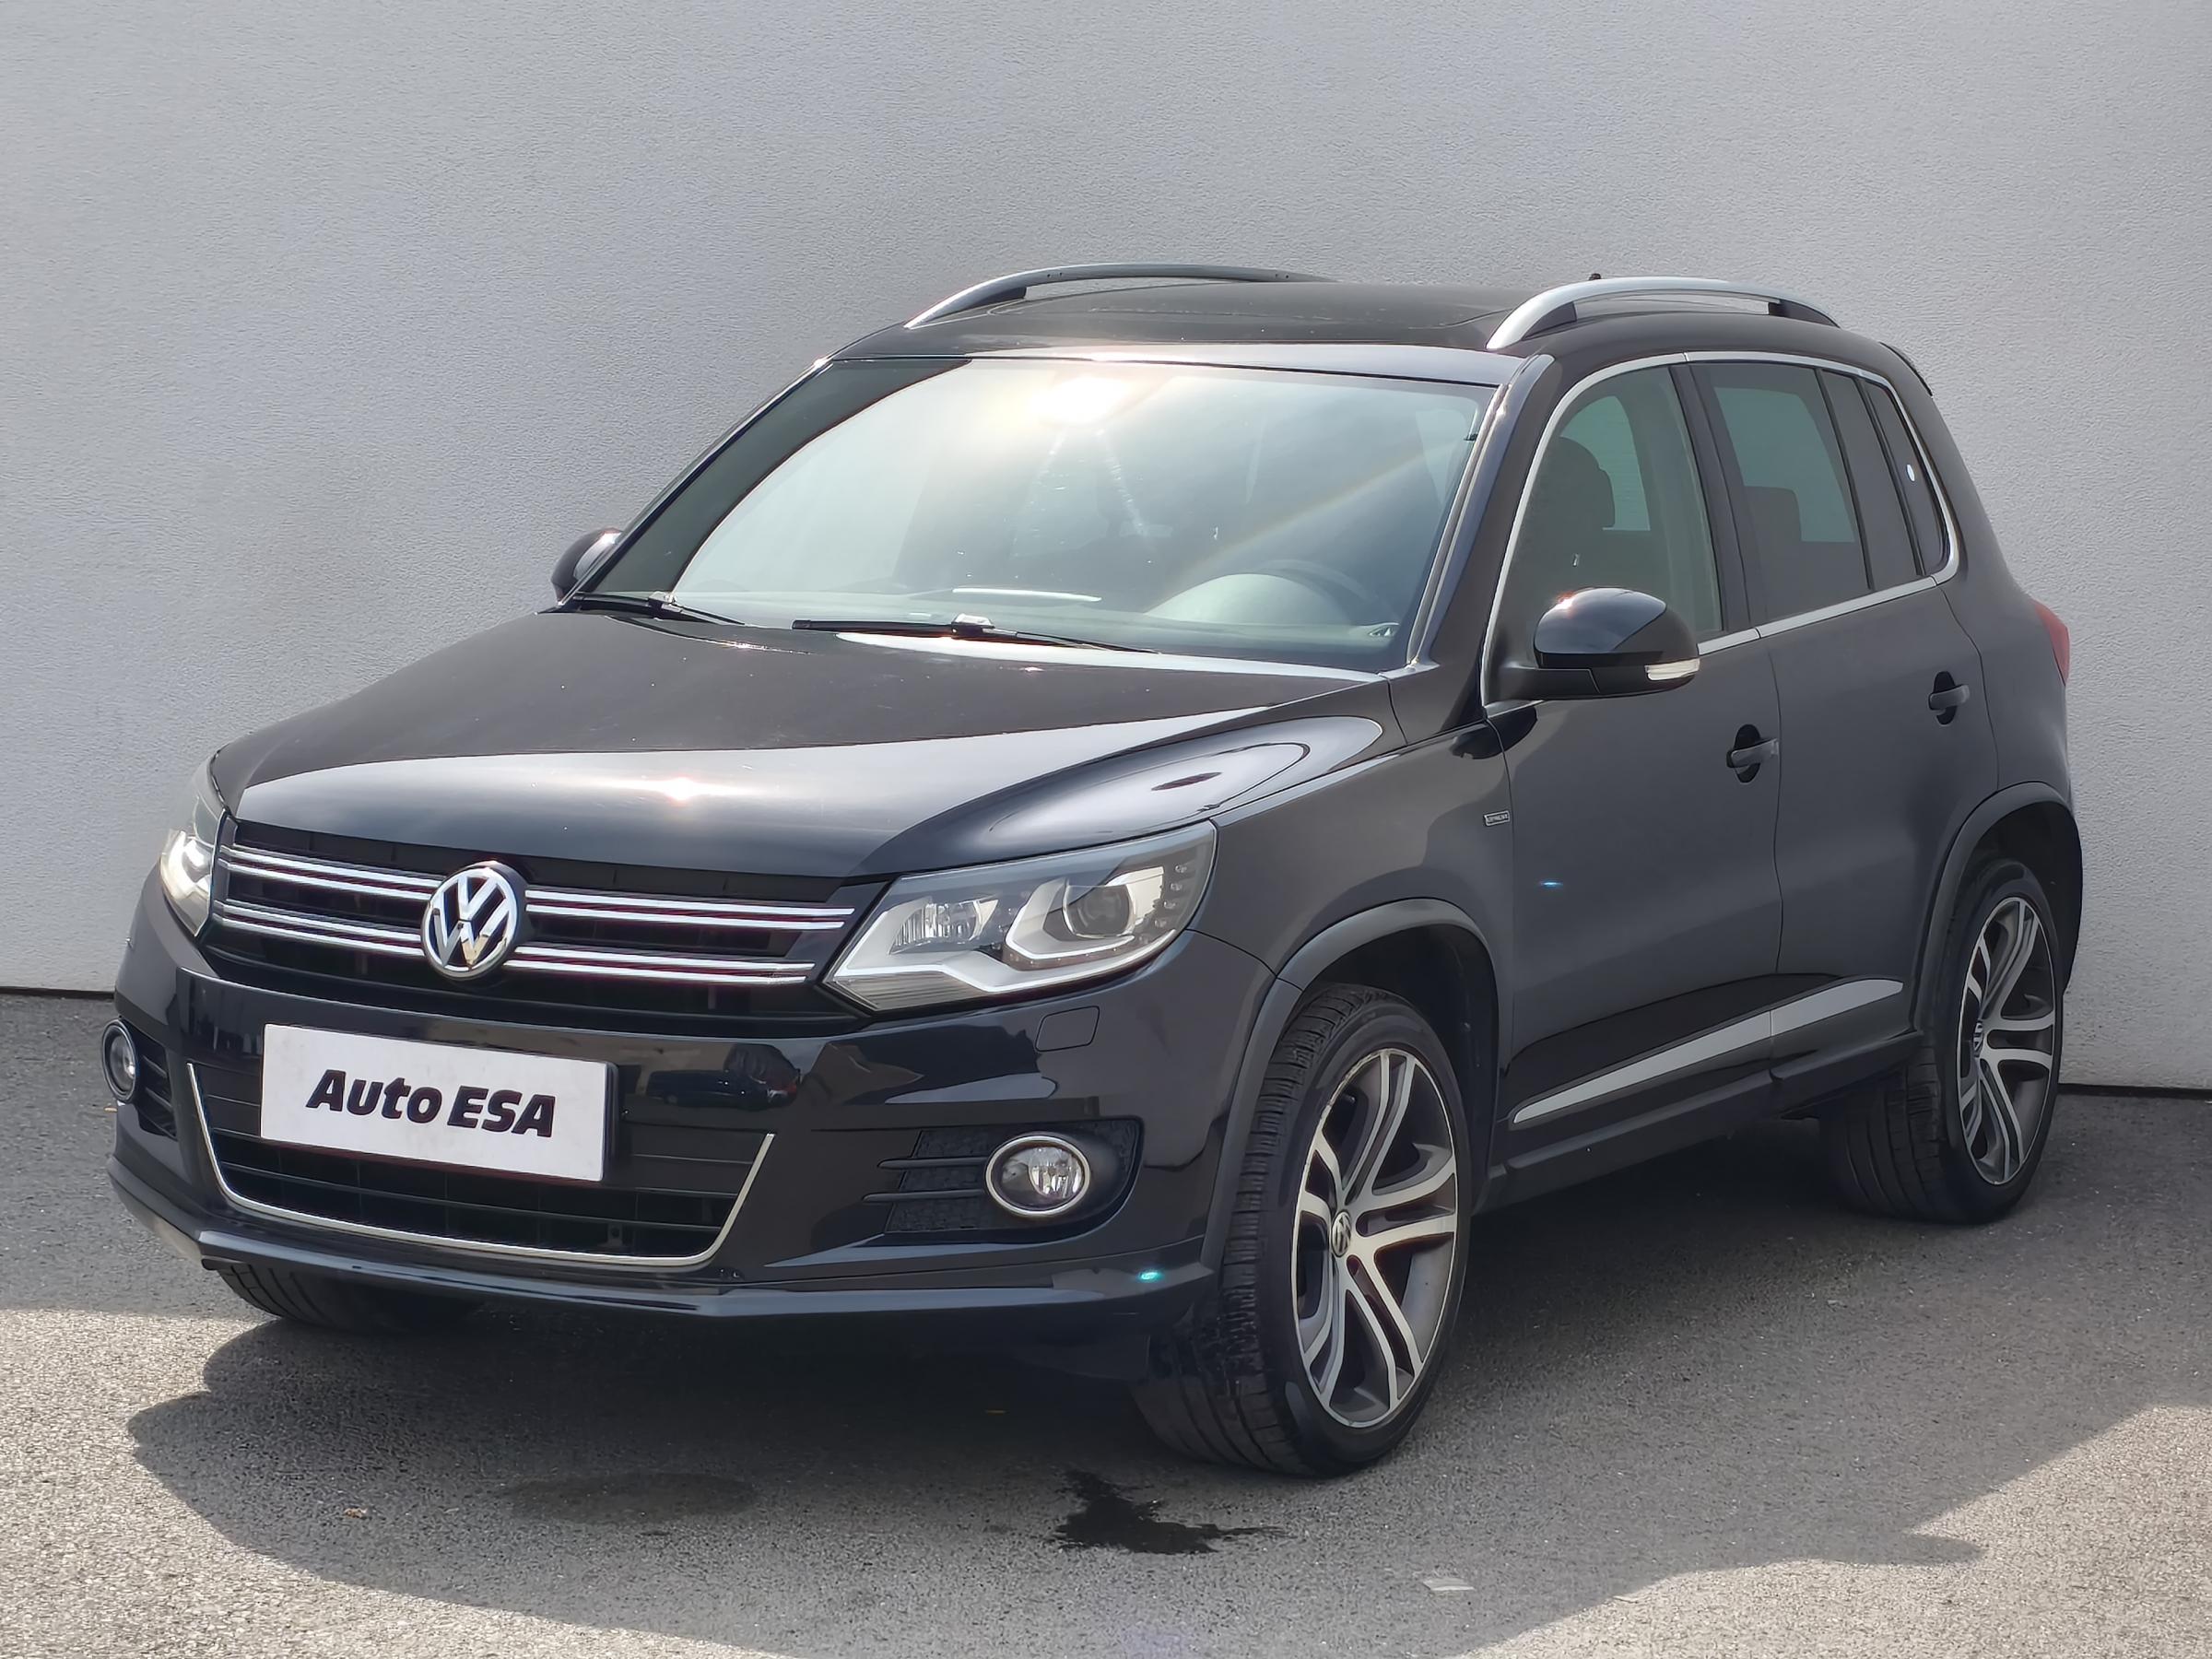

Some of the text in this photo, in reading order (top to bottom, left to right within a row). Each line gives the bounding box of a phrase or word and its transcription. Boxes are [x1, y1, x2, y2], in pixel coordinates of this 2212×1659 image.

[425, 866, 517, 973] VW
[306, 1069, 556, 1137] Auto ESA
